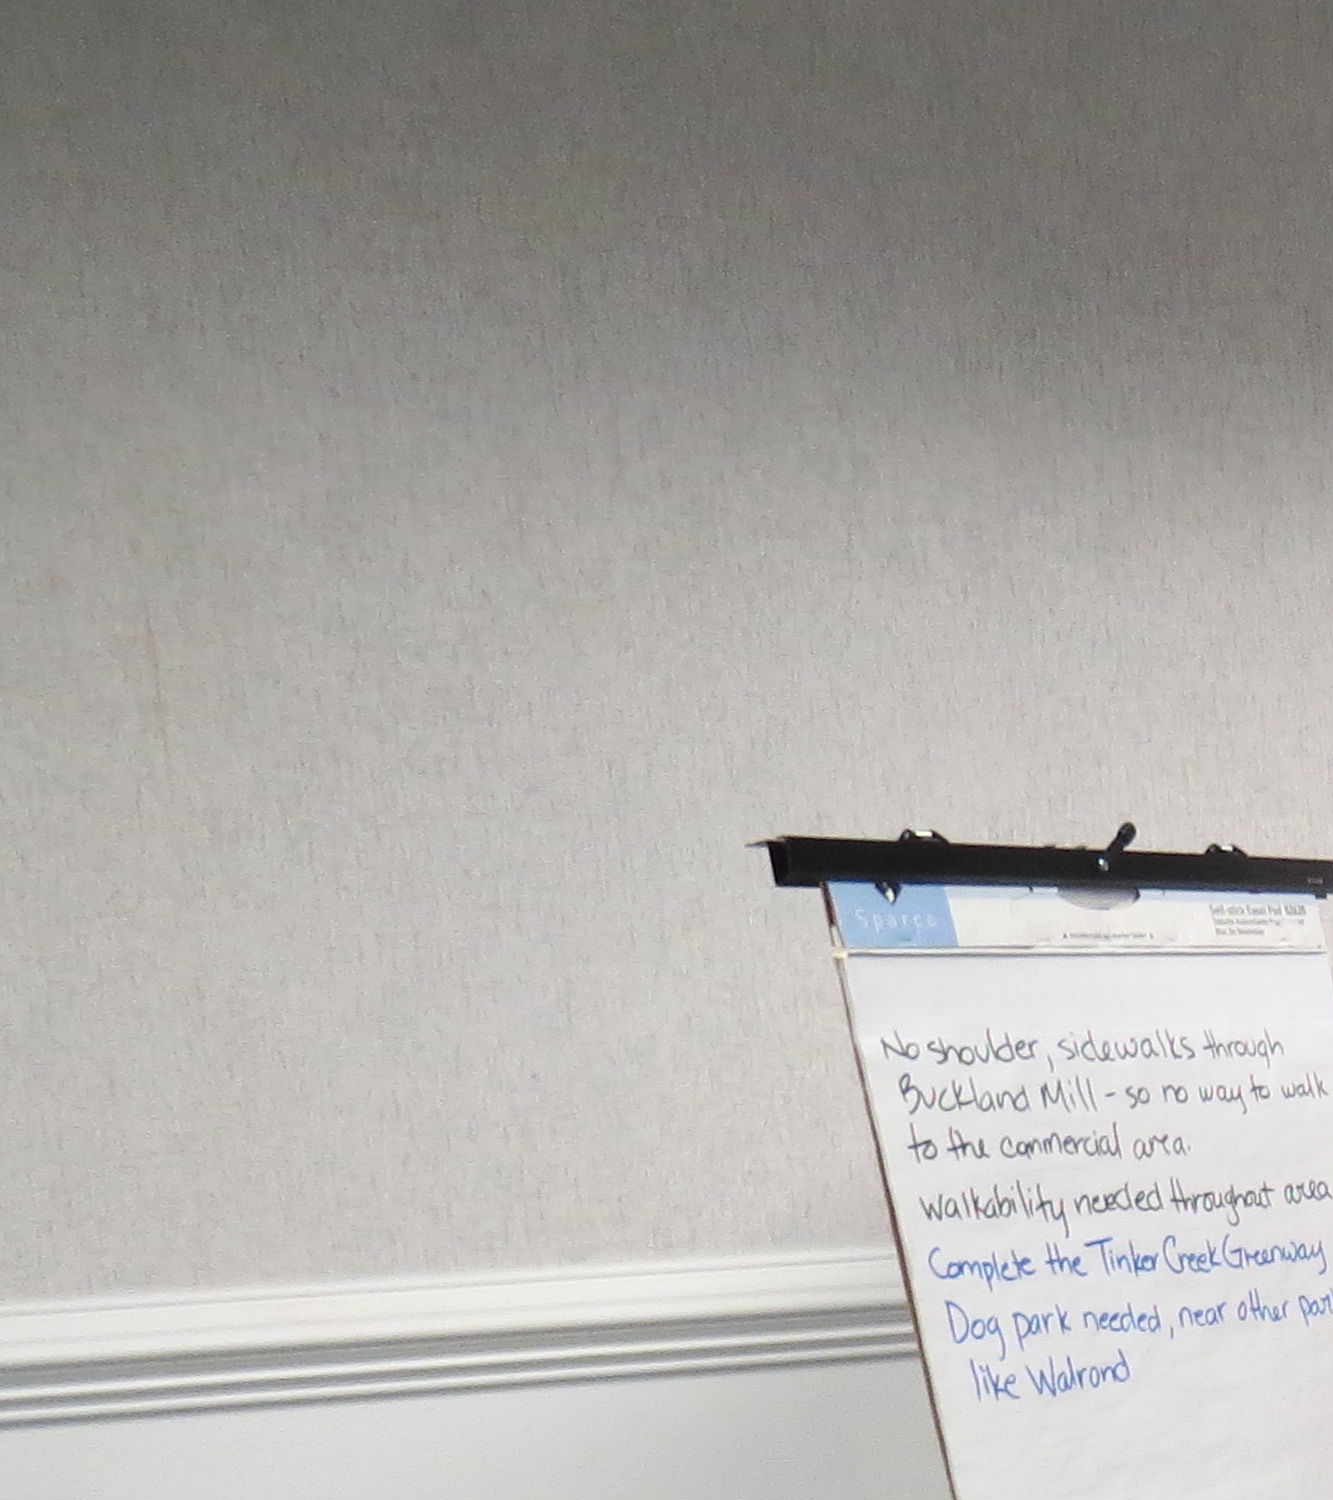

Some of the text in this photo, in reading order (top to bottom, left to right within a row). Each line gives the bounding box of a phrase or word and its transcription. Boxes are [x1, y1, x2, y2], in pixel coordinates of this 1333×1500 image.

[880, 1027, 1285, 1073] No shoulder, sidewalks through
[899, 1073, 1031, 1114] Buckland
[1040, 1075, 1098, 1113] Mill
[1125, 1085, 1150, 1109] so
[1162, 1084, 1189, 1104] no
[1198, 1085, 1248, 1115] way
[1249, 1073, 1271, 1102] to
[1281, 1071, 1329, 1100] walk
[907, 1121, 1191, 1164] to the commercial area.
[1074, 1181, 1164, 1213] needed
[1170, 1176, 1275, 1227] throughout
[928, 1233, 1328, 1293] Complete the Tinker Creek Greenway
[944, 1300, 1006, 1362] Dog
[1012, 1303, 1072, 1352] park
[1083, 1302, 1174, 1339] needed,
[1178, 1301, 1227, 1329] near
[1237, 1287, 1289, 1322] other
[969, 1348, 1131, 1401] like Walrond
